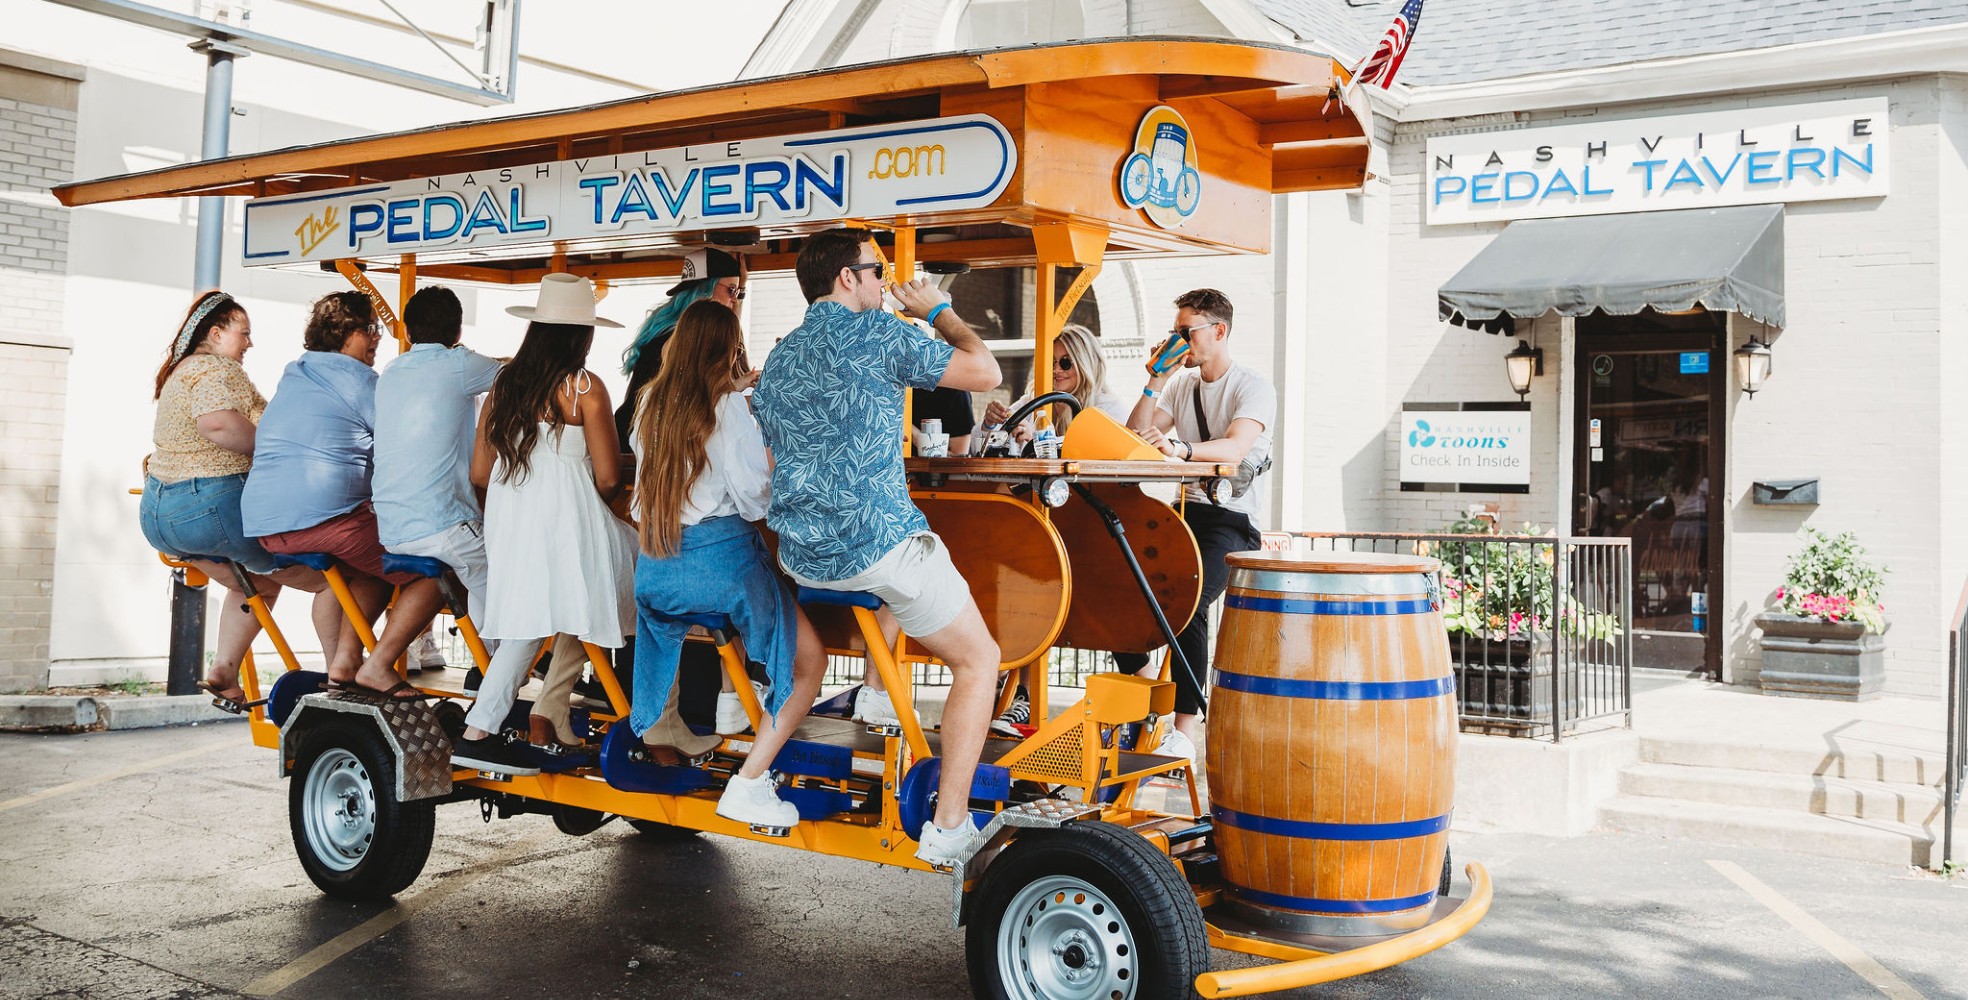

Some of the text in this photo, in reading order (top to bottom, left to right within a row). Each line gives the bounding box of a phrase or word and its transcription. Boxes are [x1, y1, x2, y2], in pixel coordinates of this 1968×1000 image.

[428, 141, 741, 190] NASHVILLE
[1436, 118, 1873, 170] NASHVILLE
[1435, 143, 1873, 206] PEDAL TAVERN
[295, 205, 340, 254] The
[349, 187, 548, 248] PEDAL
[579, 154, 845, 225] TAVERN
[1435, 425, 1521, 433] NASHVILLE
[1410, 454, 1520, 468] Check In Inside
